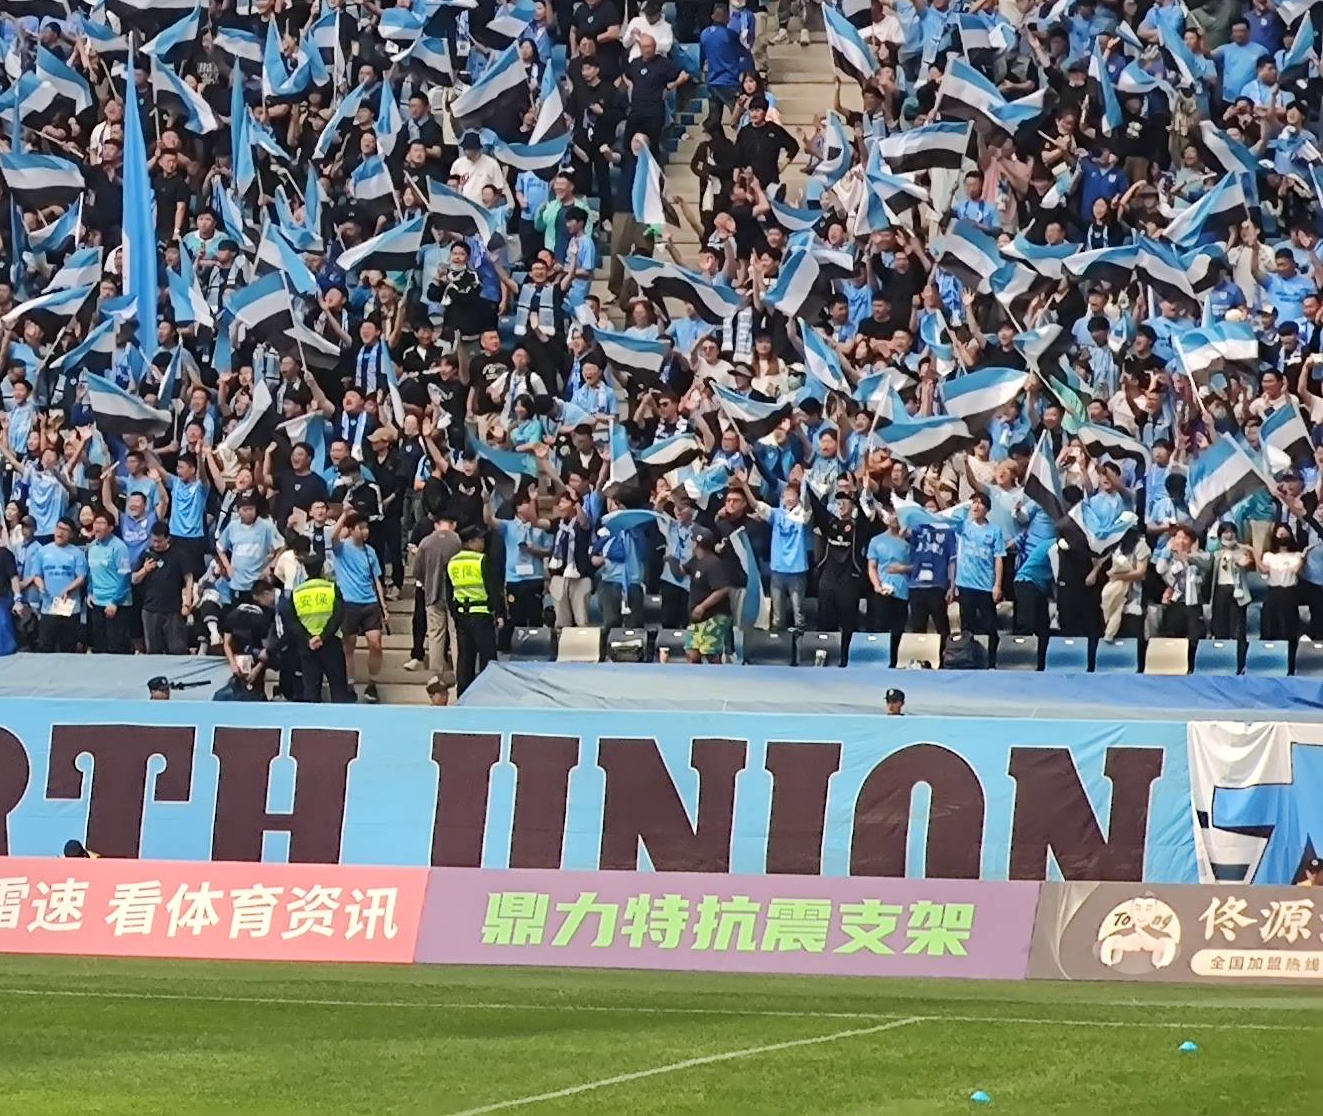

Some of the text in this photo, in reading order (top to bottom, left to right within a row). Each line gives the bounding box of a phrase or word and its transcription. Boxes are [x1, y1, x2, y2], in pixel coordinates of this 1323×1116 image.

[452, 565, 475, 579] 安保
[299, 592, 328, 608] 安保
[431, 731, 1163, 882] UNION
[105, 879, 398, 941] 看体育资讯
[481, 891, 975, 957] 鼎力特抗震支架
[1198, 895, 1323, 943] 佟源
